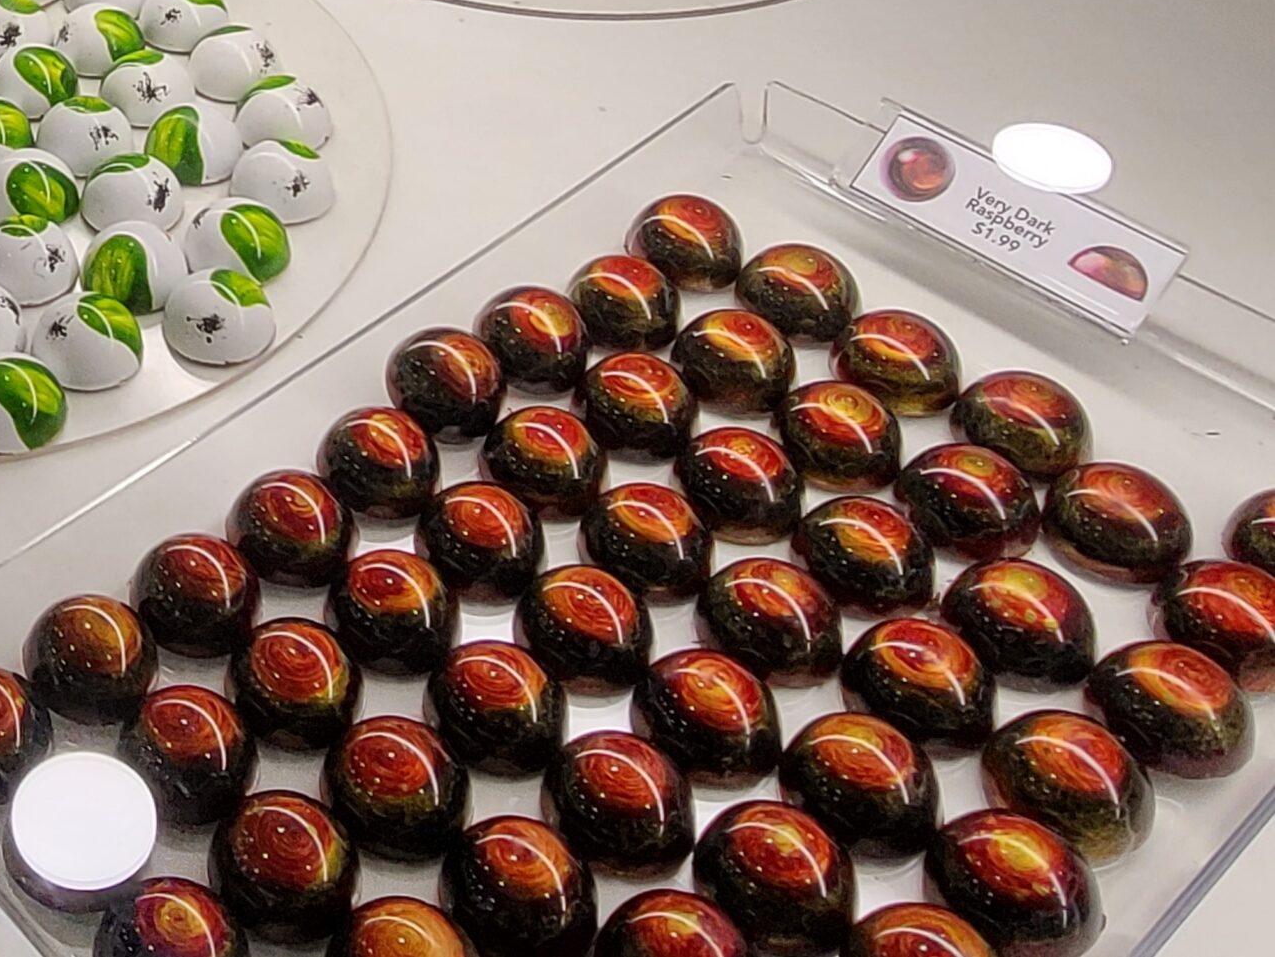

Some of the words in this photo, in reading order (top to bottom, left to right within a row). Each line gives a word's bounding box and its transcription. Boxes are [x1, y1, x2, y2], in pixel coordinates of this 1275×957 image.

[965, 197, 1050, 249] Raspberry
[976, 186, 1013, 215] Very
[1014, 206, 1056, 236] Dark
[971, 222, 1021, 252] $1.99
